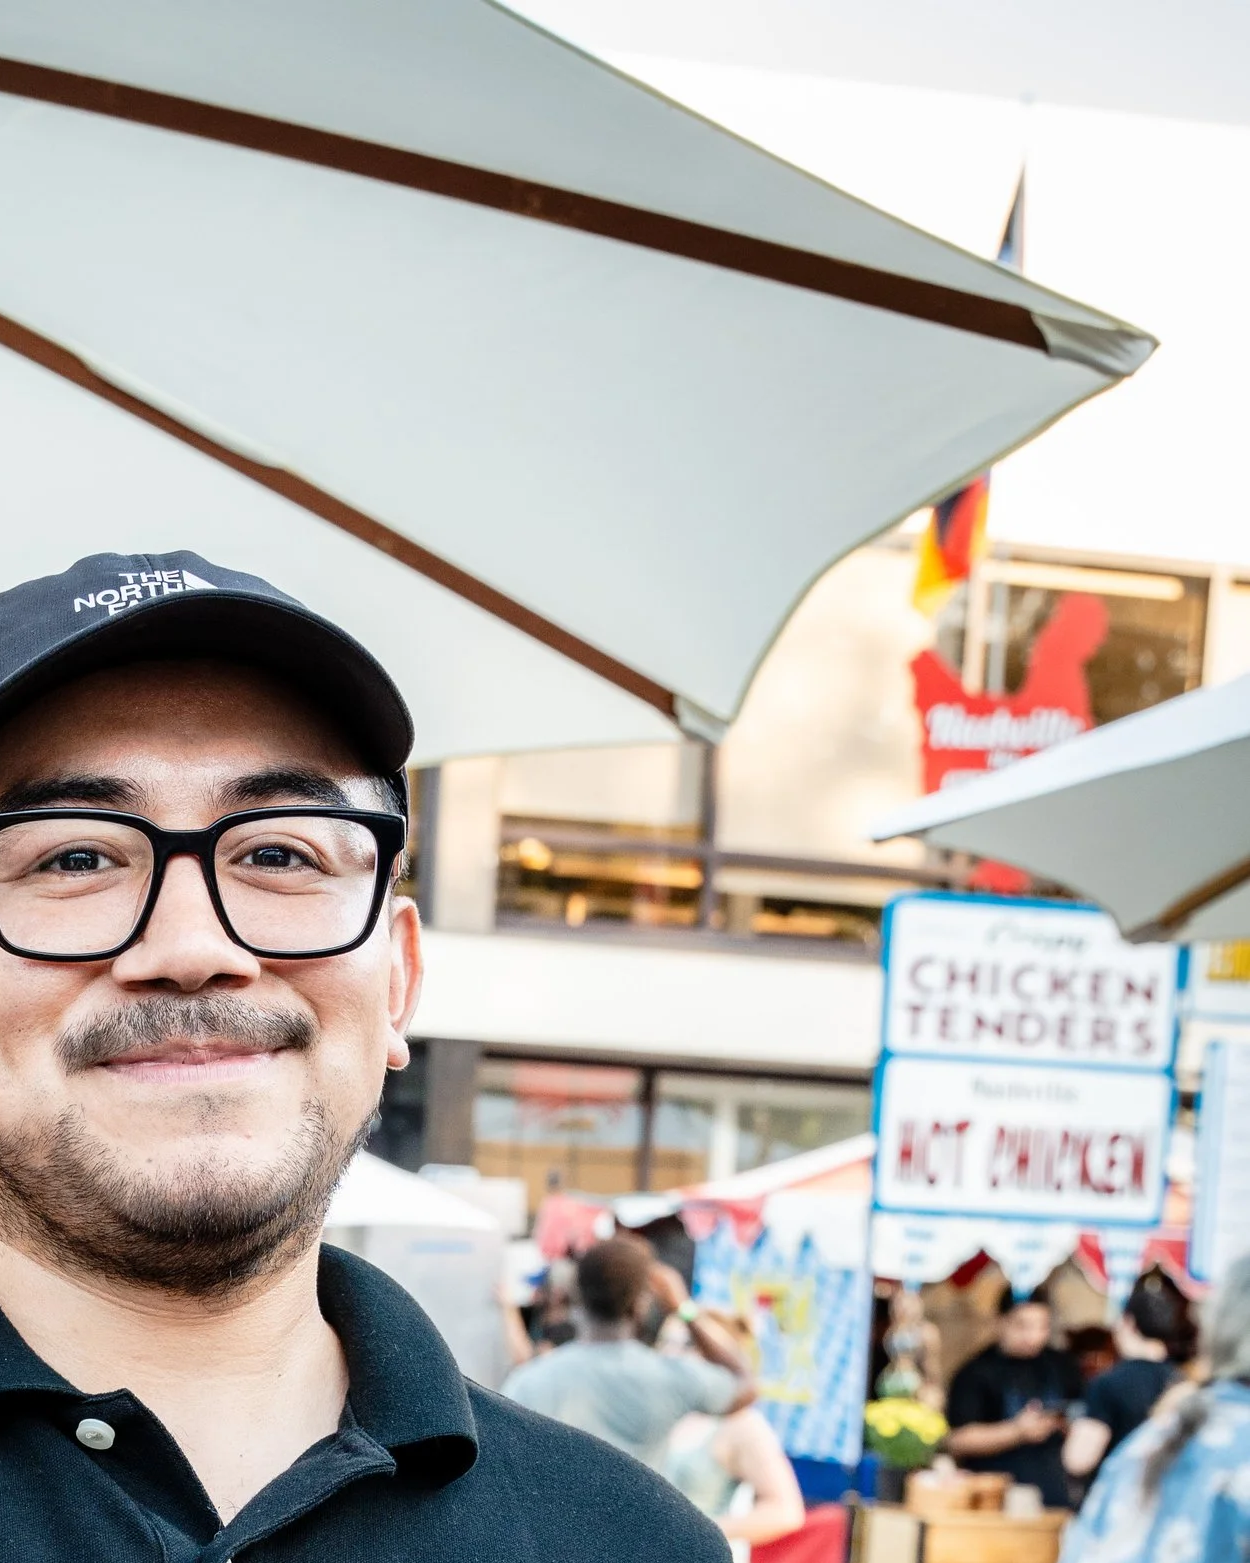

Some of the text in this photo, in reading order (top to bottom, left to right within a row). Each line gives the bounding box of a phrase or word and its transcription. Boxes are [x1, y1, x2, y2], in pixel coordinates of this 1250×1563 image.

[73, 582, 183, 613] NORTH
[119, 570, 181, 583] THE
[908, 955, 1160, 1006] CHICKEN
[906, 1003, 1157, 1056] TENDERS
[896, 1118, 1148, 1197] HOT CHICKEN
